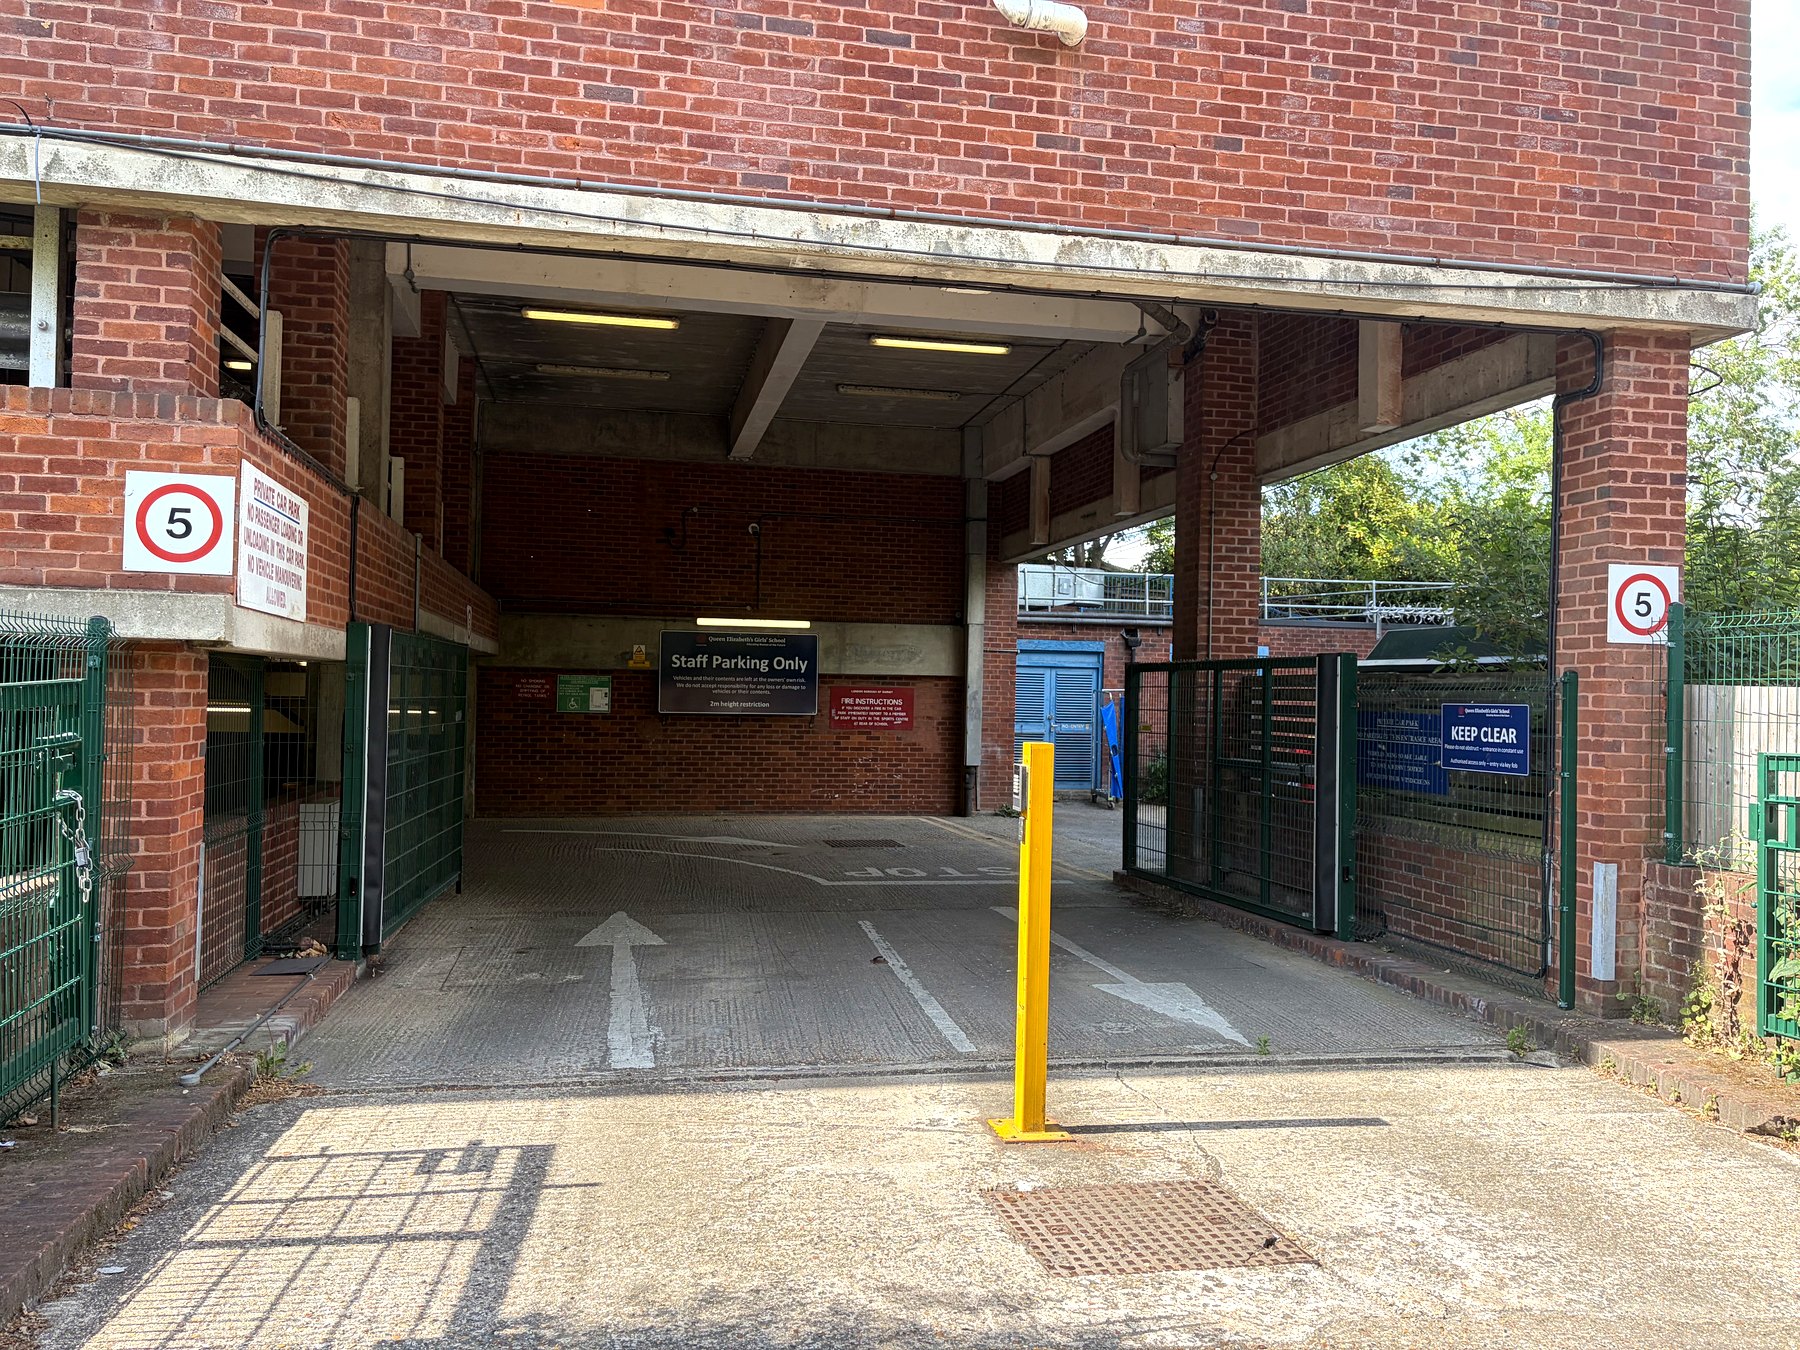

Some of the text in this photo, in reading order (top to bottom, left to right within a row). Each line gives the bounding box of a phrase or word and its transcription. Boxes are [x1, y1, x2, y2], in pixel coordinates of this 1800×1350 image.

[254, 477, 300, 521] PRIVATE CAR PARK
[165, 507, 193, 540] 5
[247, 502, 303, 546] NO PASSENGER LOADING OR
[244, 526, 270, 552] UNLOADING
[270, 538, 274, 556] IN
[276, 540, 285, 561] THIS
[286, 546, 294, 566] CAR
[247, 554, 254, 574] NO
[256, 556, 274, 580] VEHICLE
[1634, 592, 1652, 618] 5
[671, 654, 808, 673] Staff Parking Only
[855, 698, 903, 706] INSTRUCTIONS
[1451, 726, 1517, 744] KEEP CLEAR
[844, 866, 1019, 877] STOP
